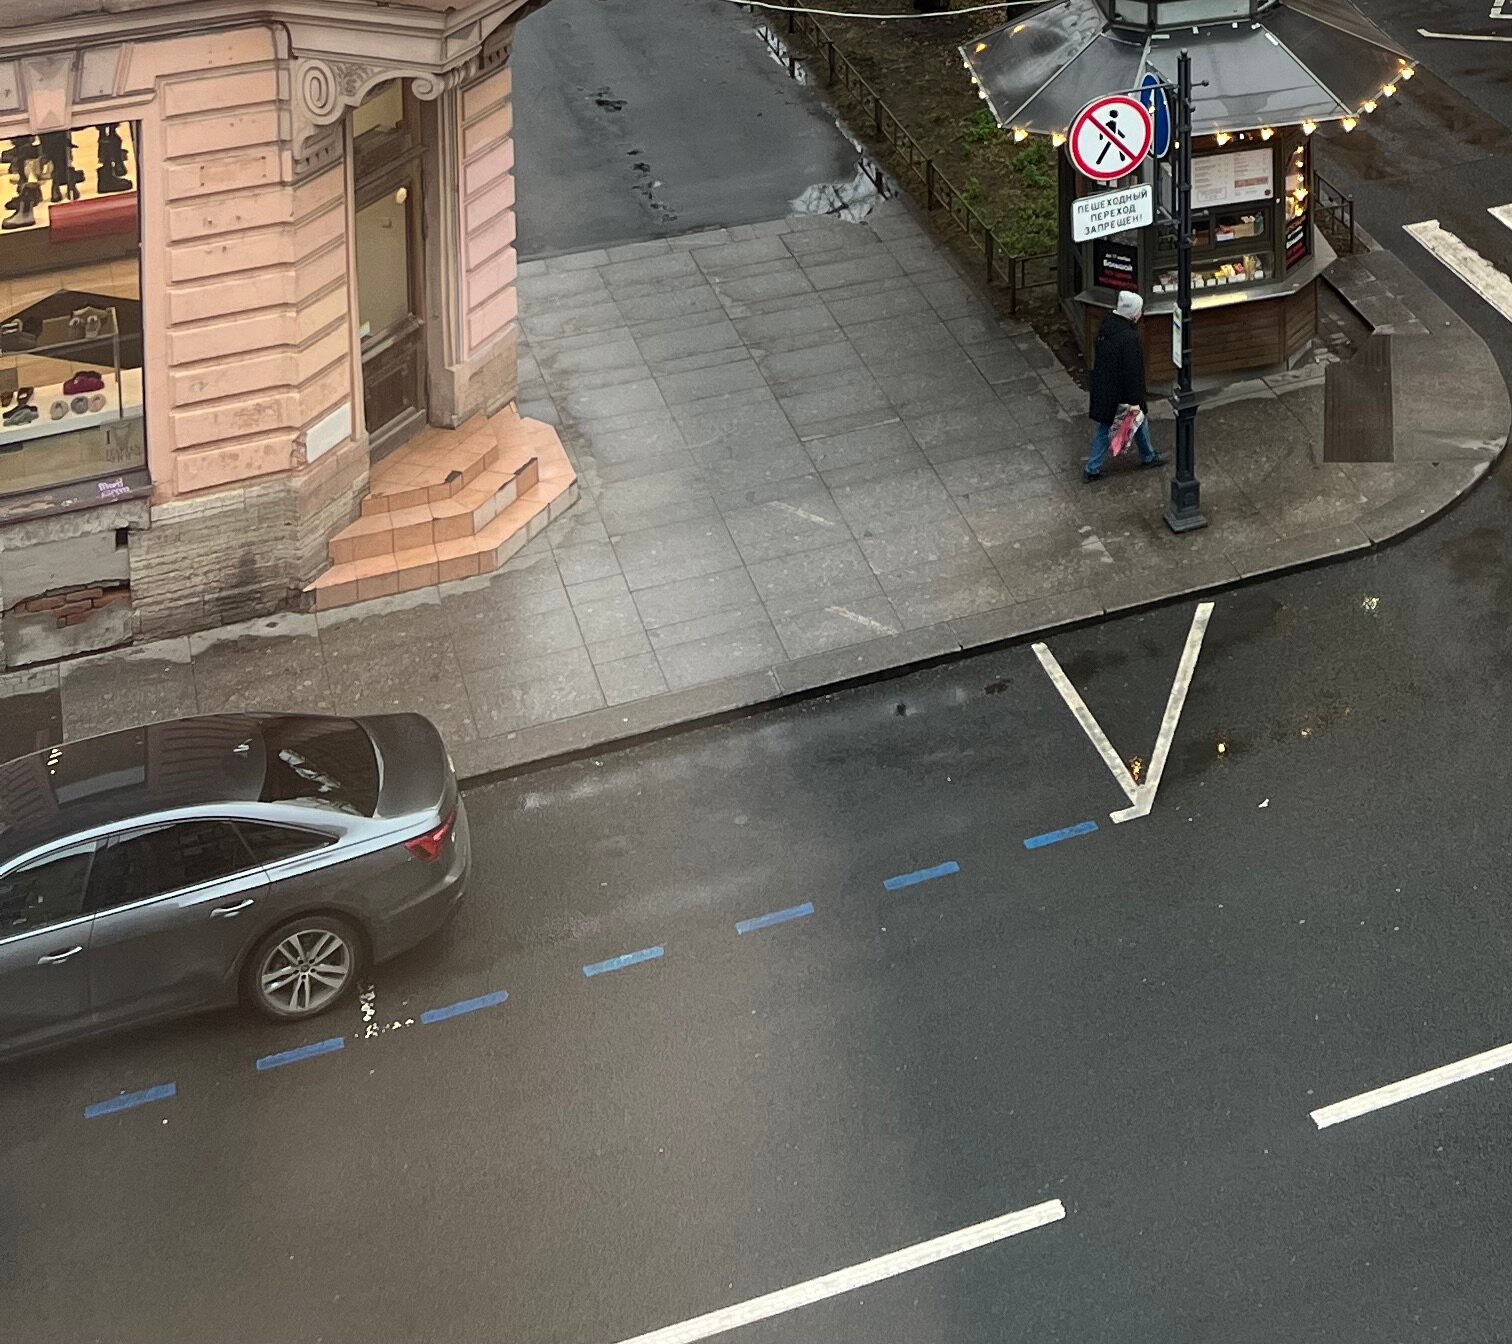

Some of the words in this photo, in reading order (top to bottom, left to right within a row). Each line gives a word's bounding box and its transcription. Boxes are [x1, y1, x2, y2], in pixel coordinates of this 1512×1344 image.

[1077, 189, 1148, 214] ПЕШЕХОДНЫЙ
[1090, 204, 1137, 223] ПЕРЕХОД
[1084, 214, 1143, 236] ЗАПРЕЩЕН!
